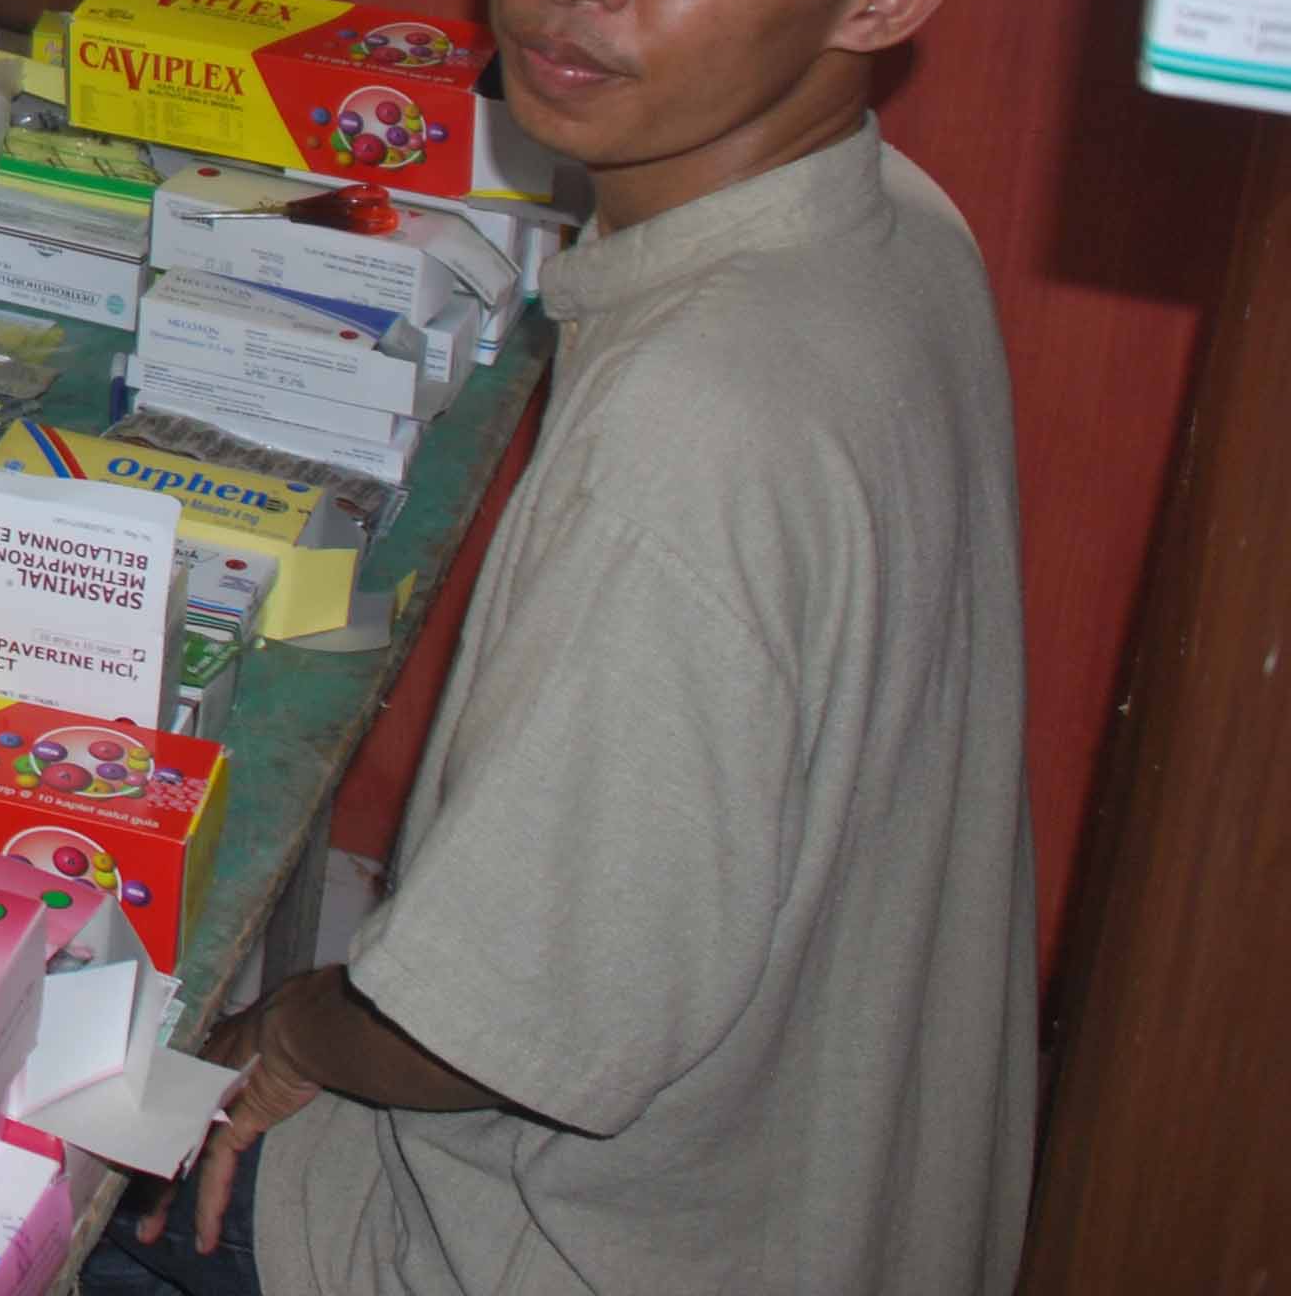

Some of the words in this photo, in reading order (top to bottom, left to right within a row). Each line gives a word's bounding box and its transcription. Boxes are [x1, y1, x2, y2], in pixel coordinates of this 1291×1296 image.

[78, 40, 247, 96] CAVIPLEX
[108, 457, 268, 508] Orphen
[17, 529, 150, 571] BELLADONNA
[15, 567, 145, 610] SPASMINAL
[38, 792, 54, 804] 10
